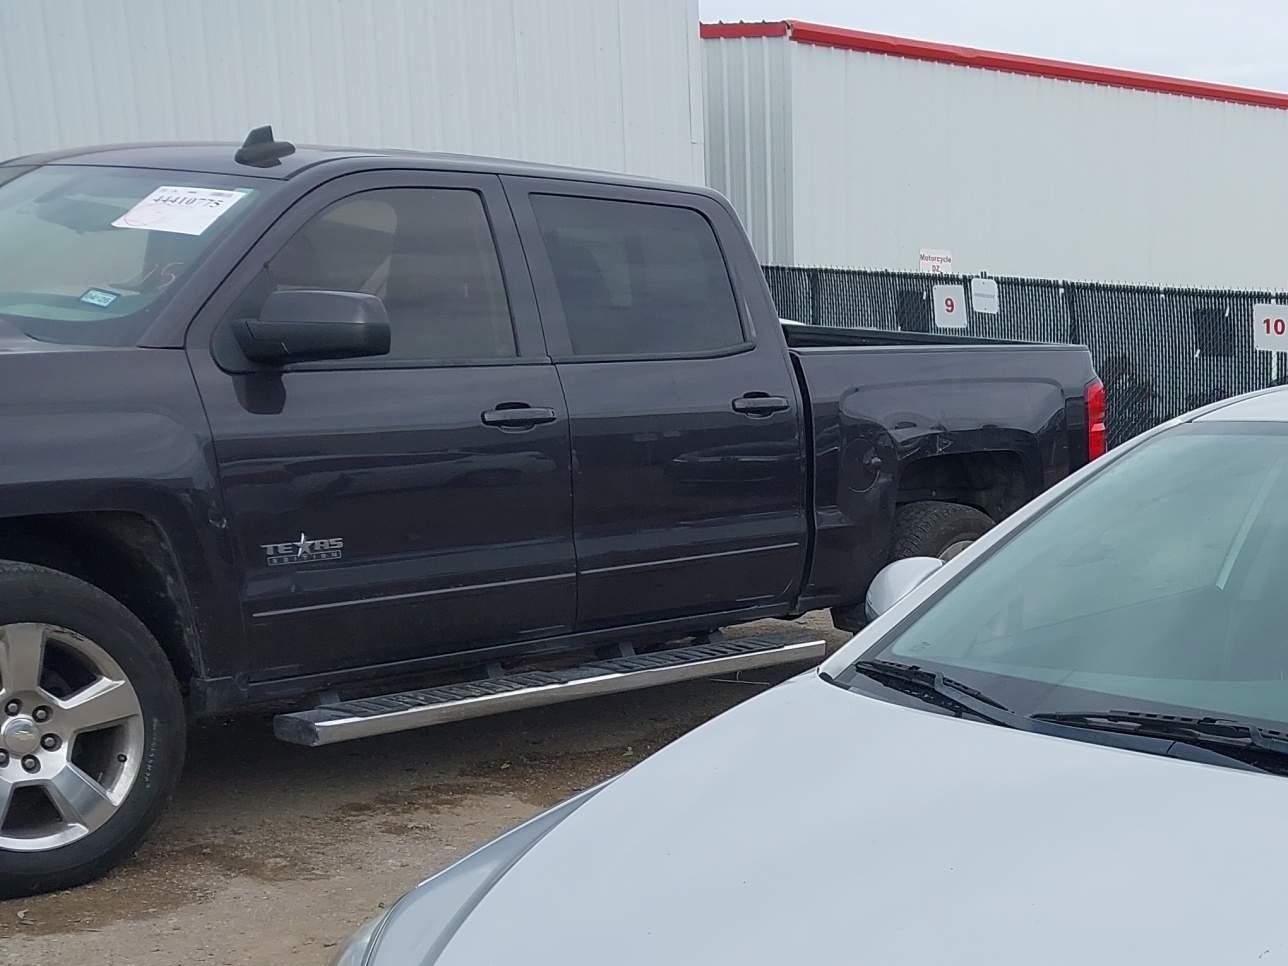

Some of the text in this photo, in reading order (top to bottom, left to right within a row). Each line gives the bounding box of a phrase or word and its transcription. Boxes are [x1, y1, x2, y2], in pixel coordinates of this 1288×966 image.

[944, 297, 955, 314] 9
[1262, 318, 1286, 336] 10
[259, 536, 343, 556] TEXAS
